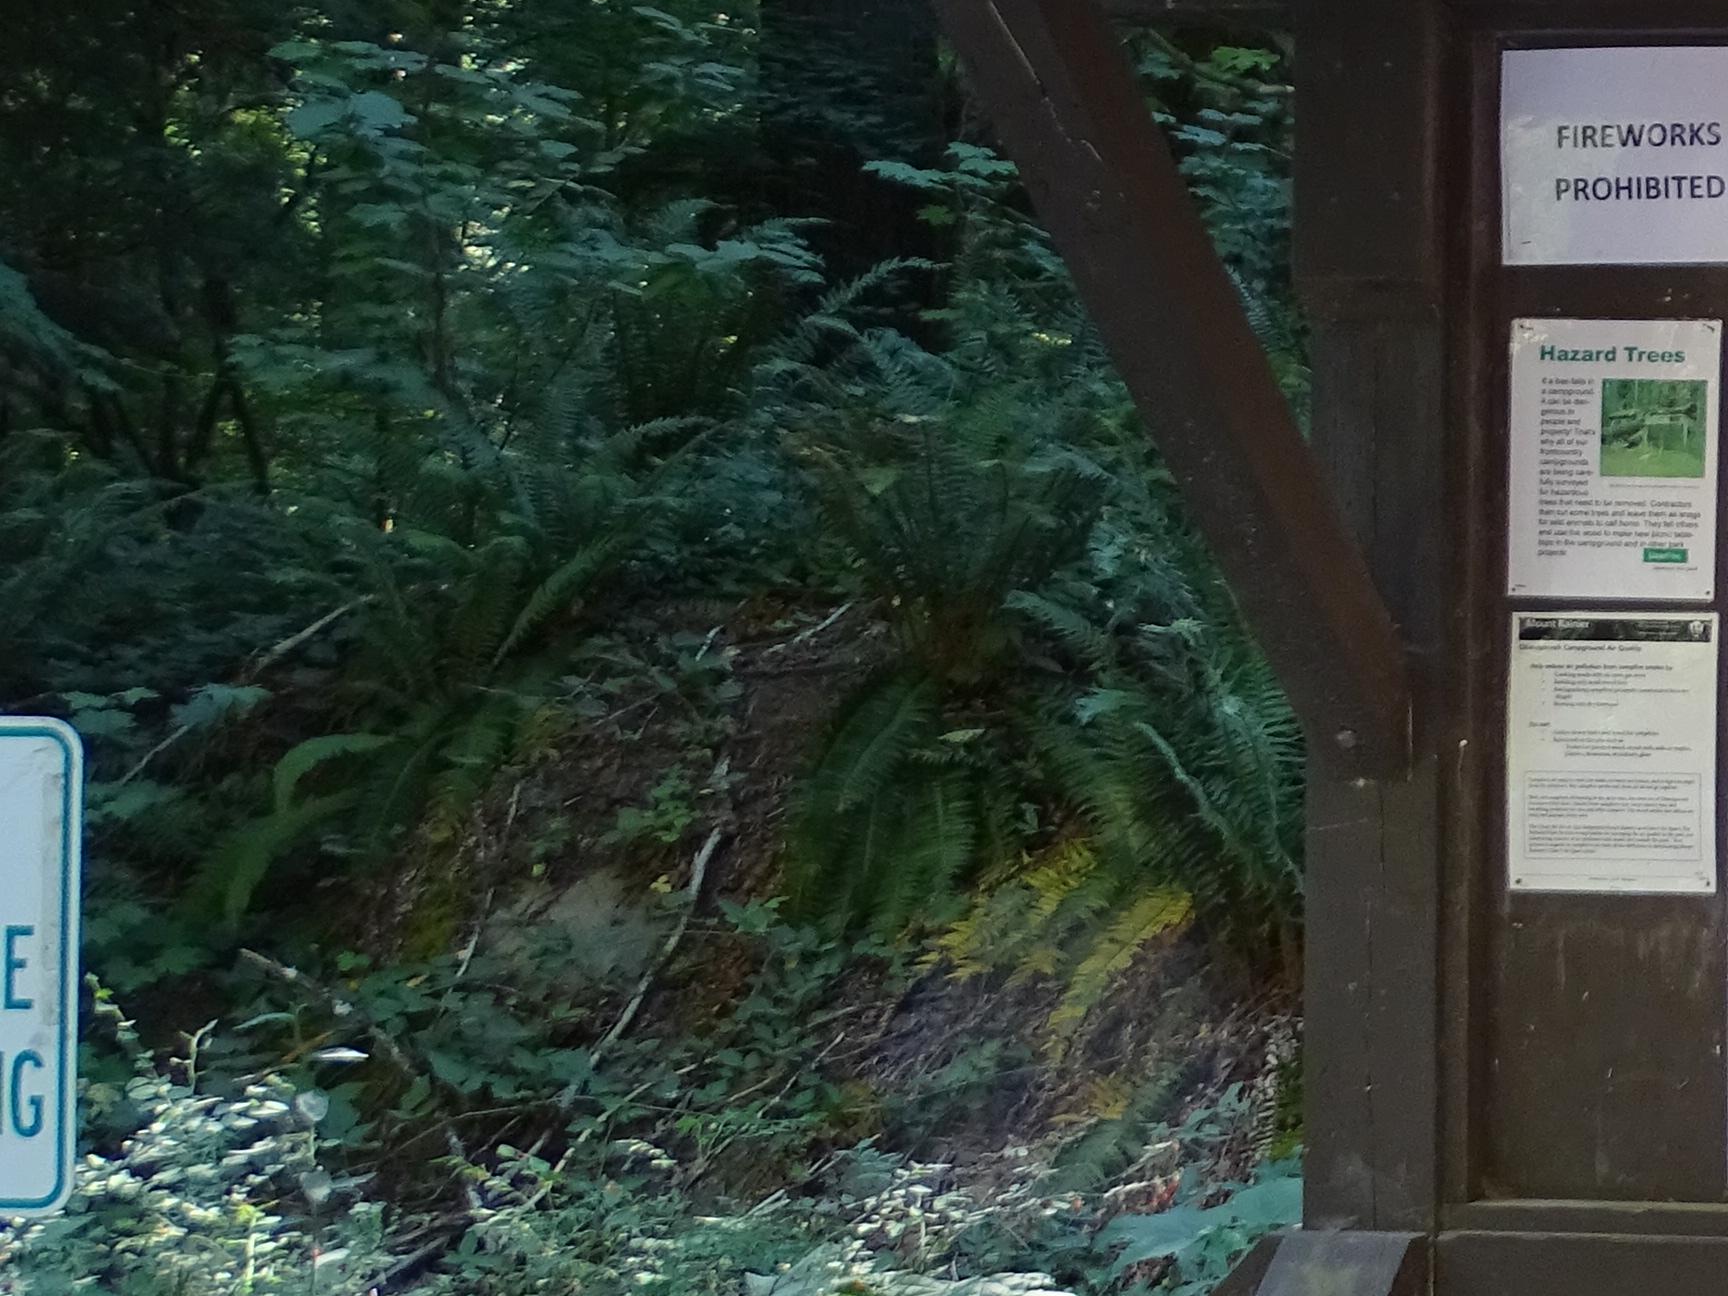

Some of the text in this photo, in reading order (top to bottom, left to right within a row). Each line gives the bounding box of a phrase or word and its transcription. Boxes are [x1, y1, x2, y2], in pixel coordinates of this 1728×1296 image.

[1558, 122, 1721, 149] FIREWORKS
[1556, 176, 1725, 201] PROHIBITED
[1540, 345, 1685, 363] Hazard Trees
